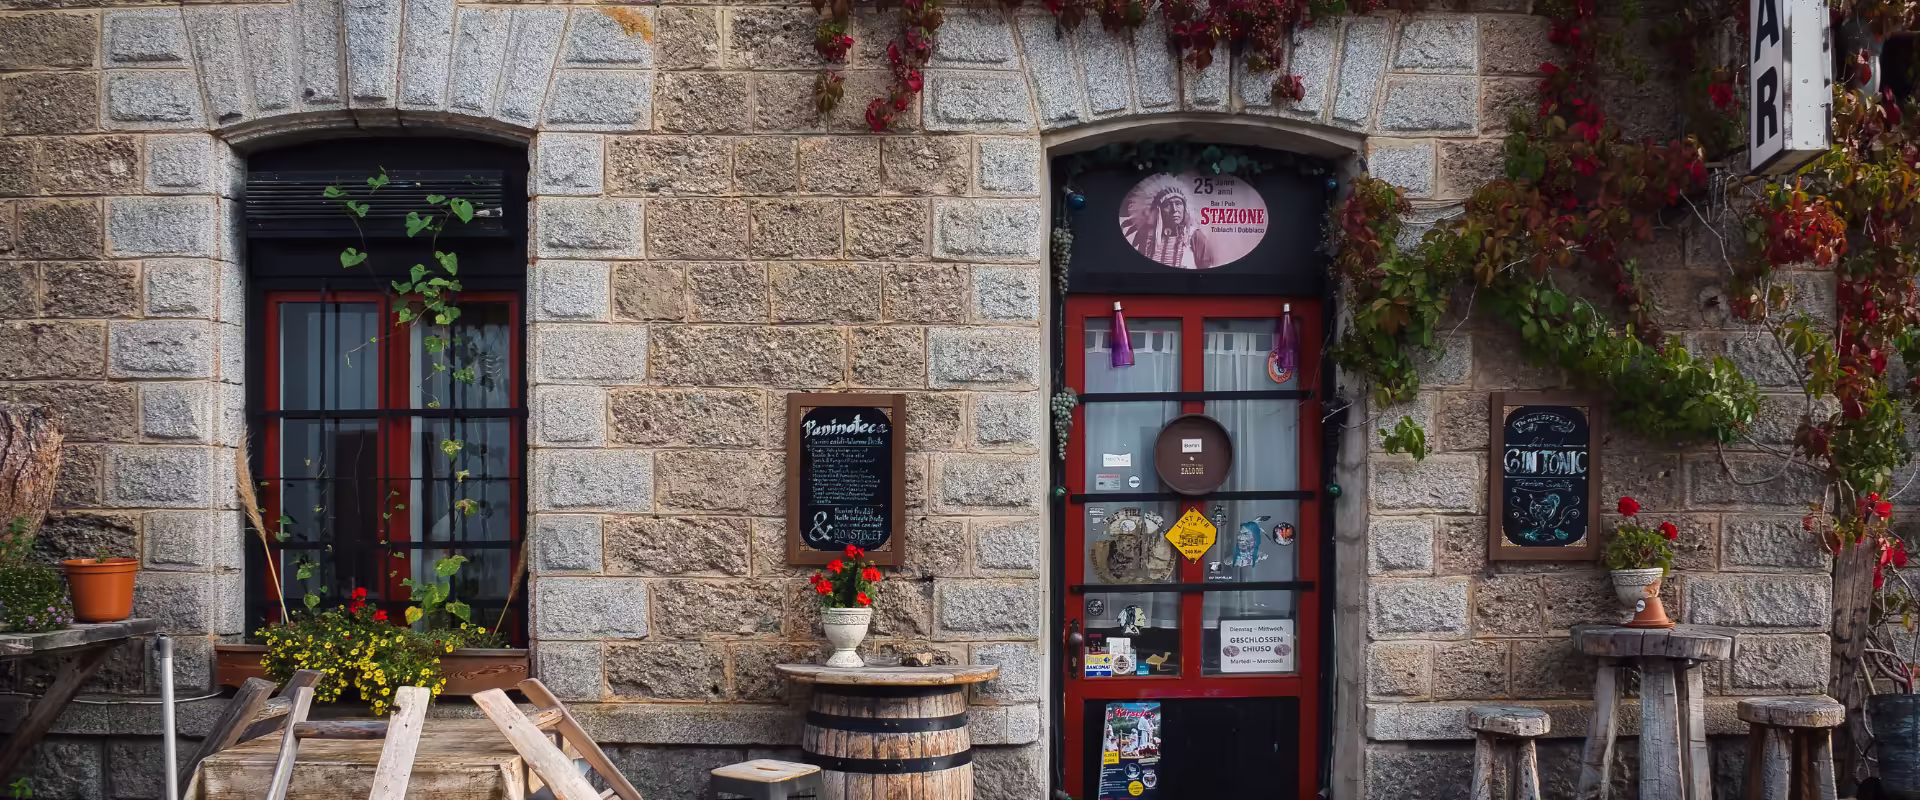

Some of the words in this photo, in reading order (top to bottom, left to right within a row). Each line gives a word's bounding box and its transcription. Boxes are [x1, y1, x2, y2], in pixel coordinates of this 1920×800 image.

[1193, 177, 1213, 195] 25
[1200, 207, 1264, 225] STAZIONE
[803, 414, 888, 439] Paninoteca
[1504, 448, 1539, 474] GIN
[1538, 449, 1588, 475] TONIC
[1175, 515, 1193, 530] LAST
[1195, 516, 1211, 529] PUB
[1229, 636, 1284, 644] GESCHLOSSEN
